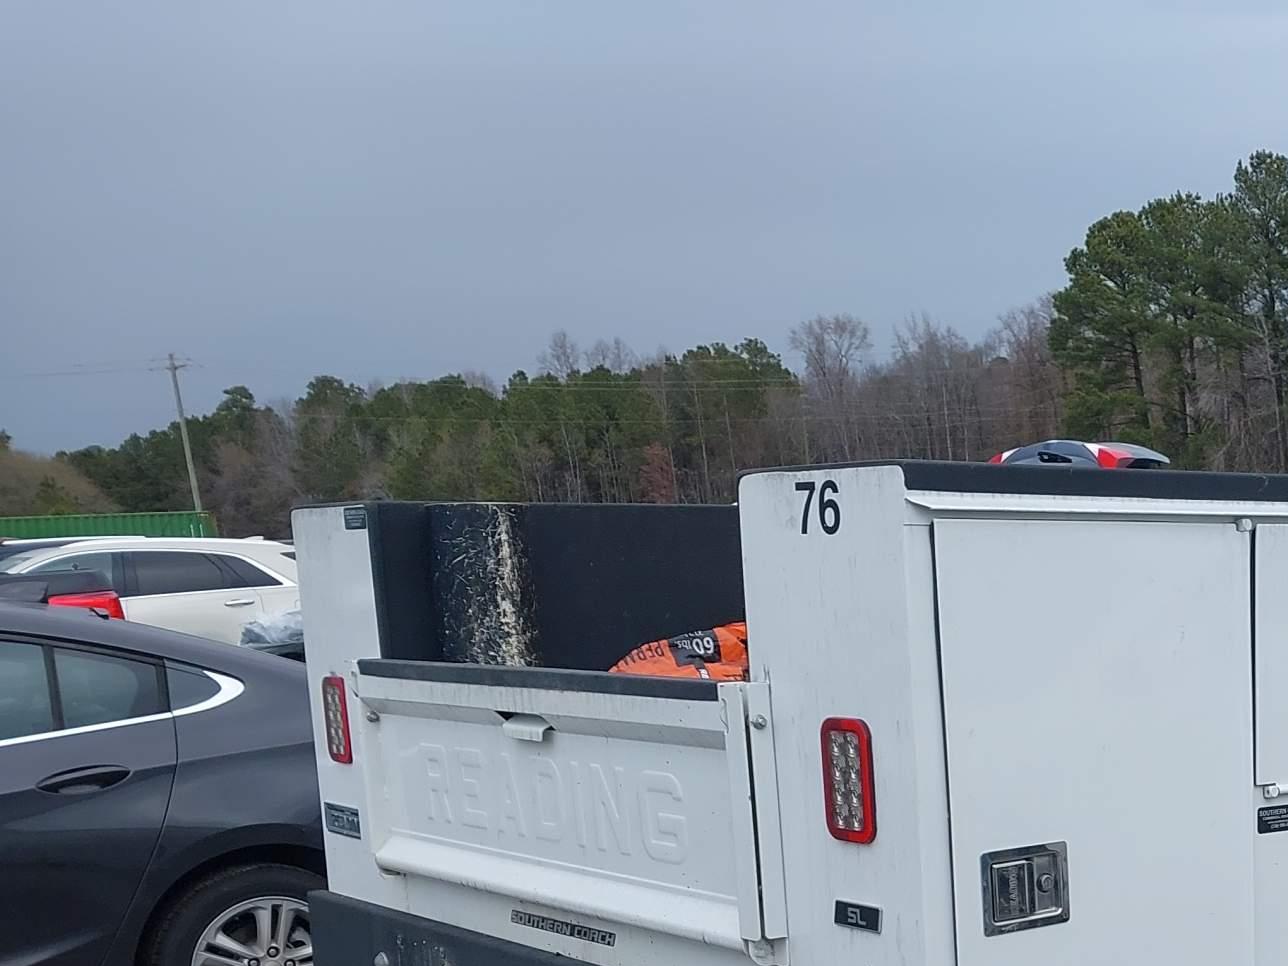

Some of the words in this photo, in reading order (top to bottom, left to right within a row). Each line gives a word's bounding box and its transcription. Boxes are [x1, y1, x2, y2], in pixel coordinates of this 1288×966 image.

[795, 480, 840, 535] 76
[692, 637, 714, 655] 60
[418, 742, 688, 865] READING
[511, 911, 571, 936] SOUTHERN
[574, 926, 616, 947] COACH
[847, 907, 867, 926] SL
